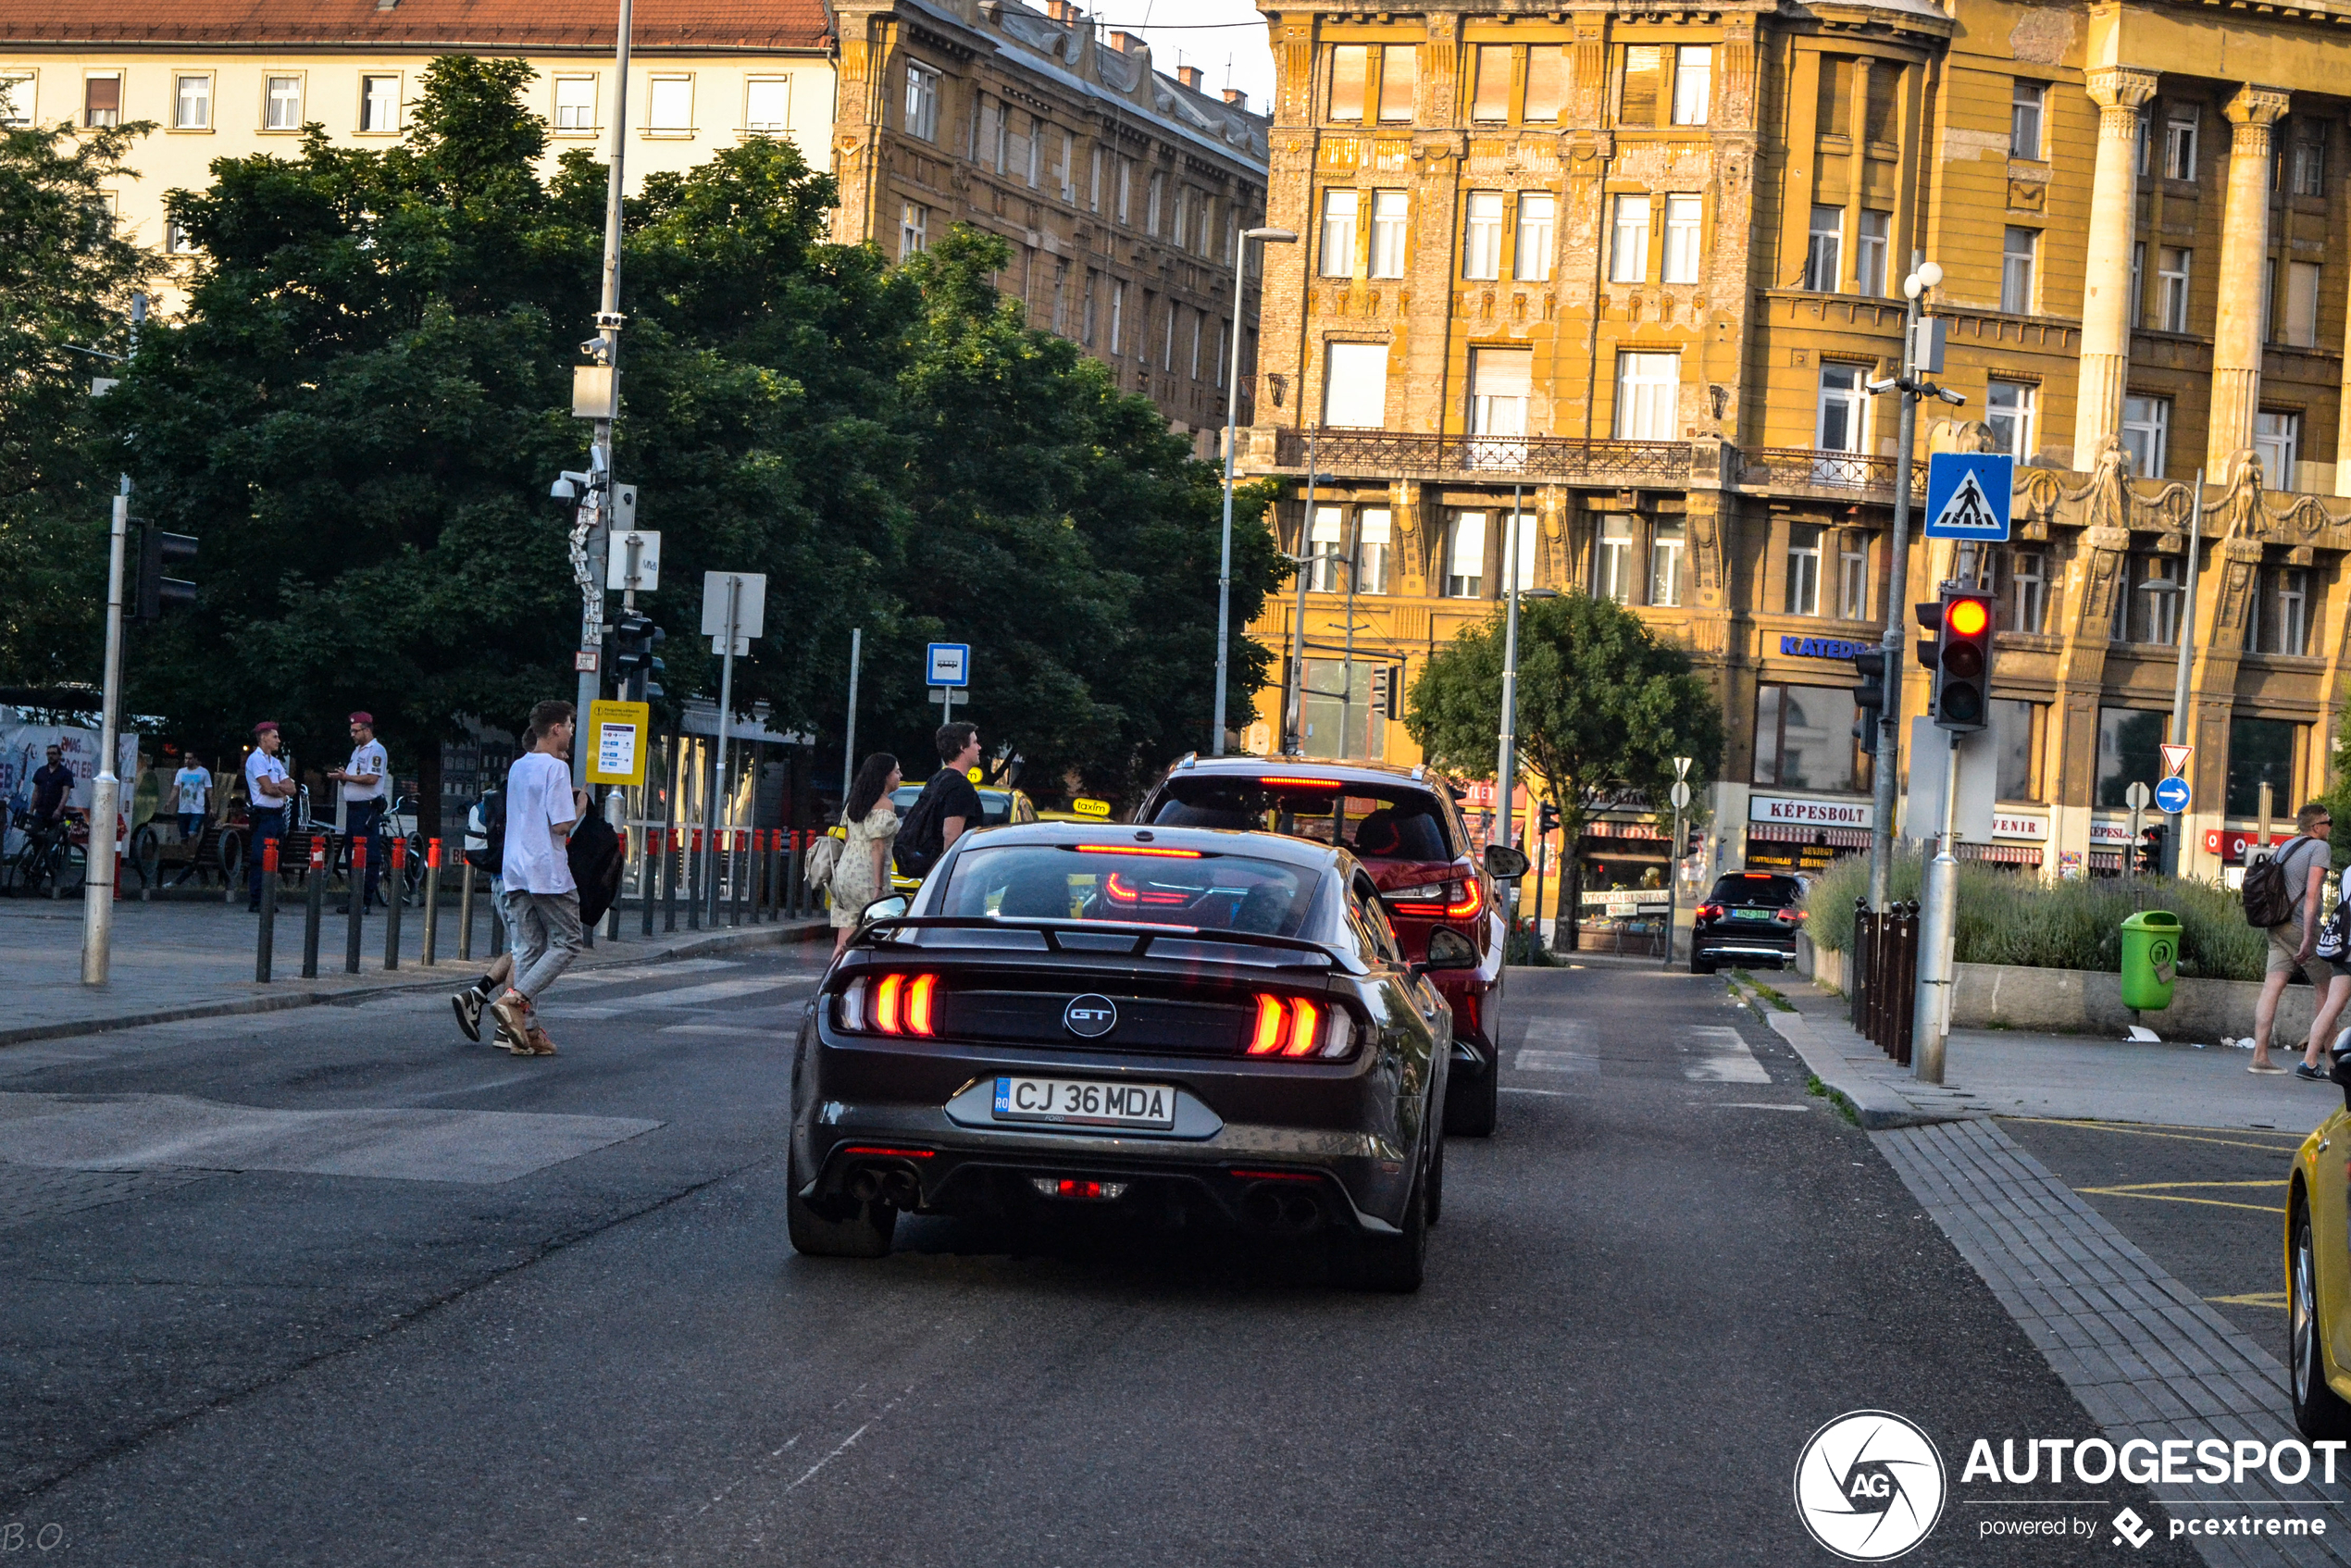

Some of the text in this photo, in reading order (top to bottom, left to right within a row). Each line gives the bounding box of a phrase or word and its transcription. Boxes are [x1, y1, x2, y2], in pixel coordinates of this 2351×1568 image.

[1780, 635, 1876, 659] KATEDR
[1076, 801, 1106, 813] taxim
[1770, 800, 1865, 823] KÉPESBOLT
[1070, 1008, 1112, 1020] GT
[995, 1097, 1008, 1109] RO
[1015, 1081, 1164, 1118] CJ 36 MDA
